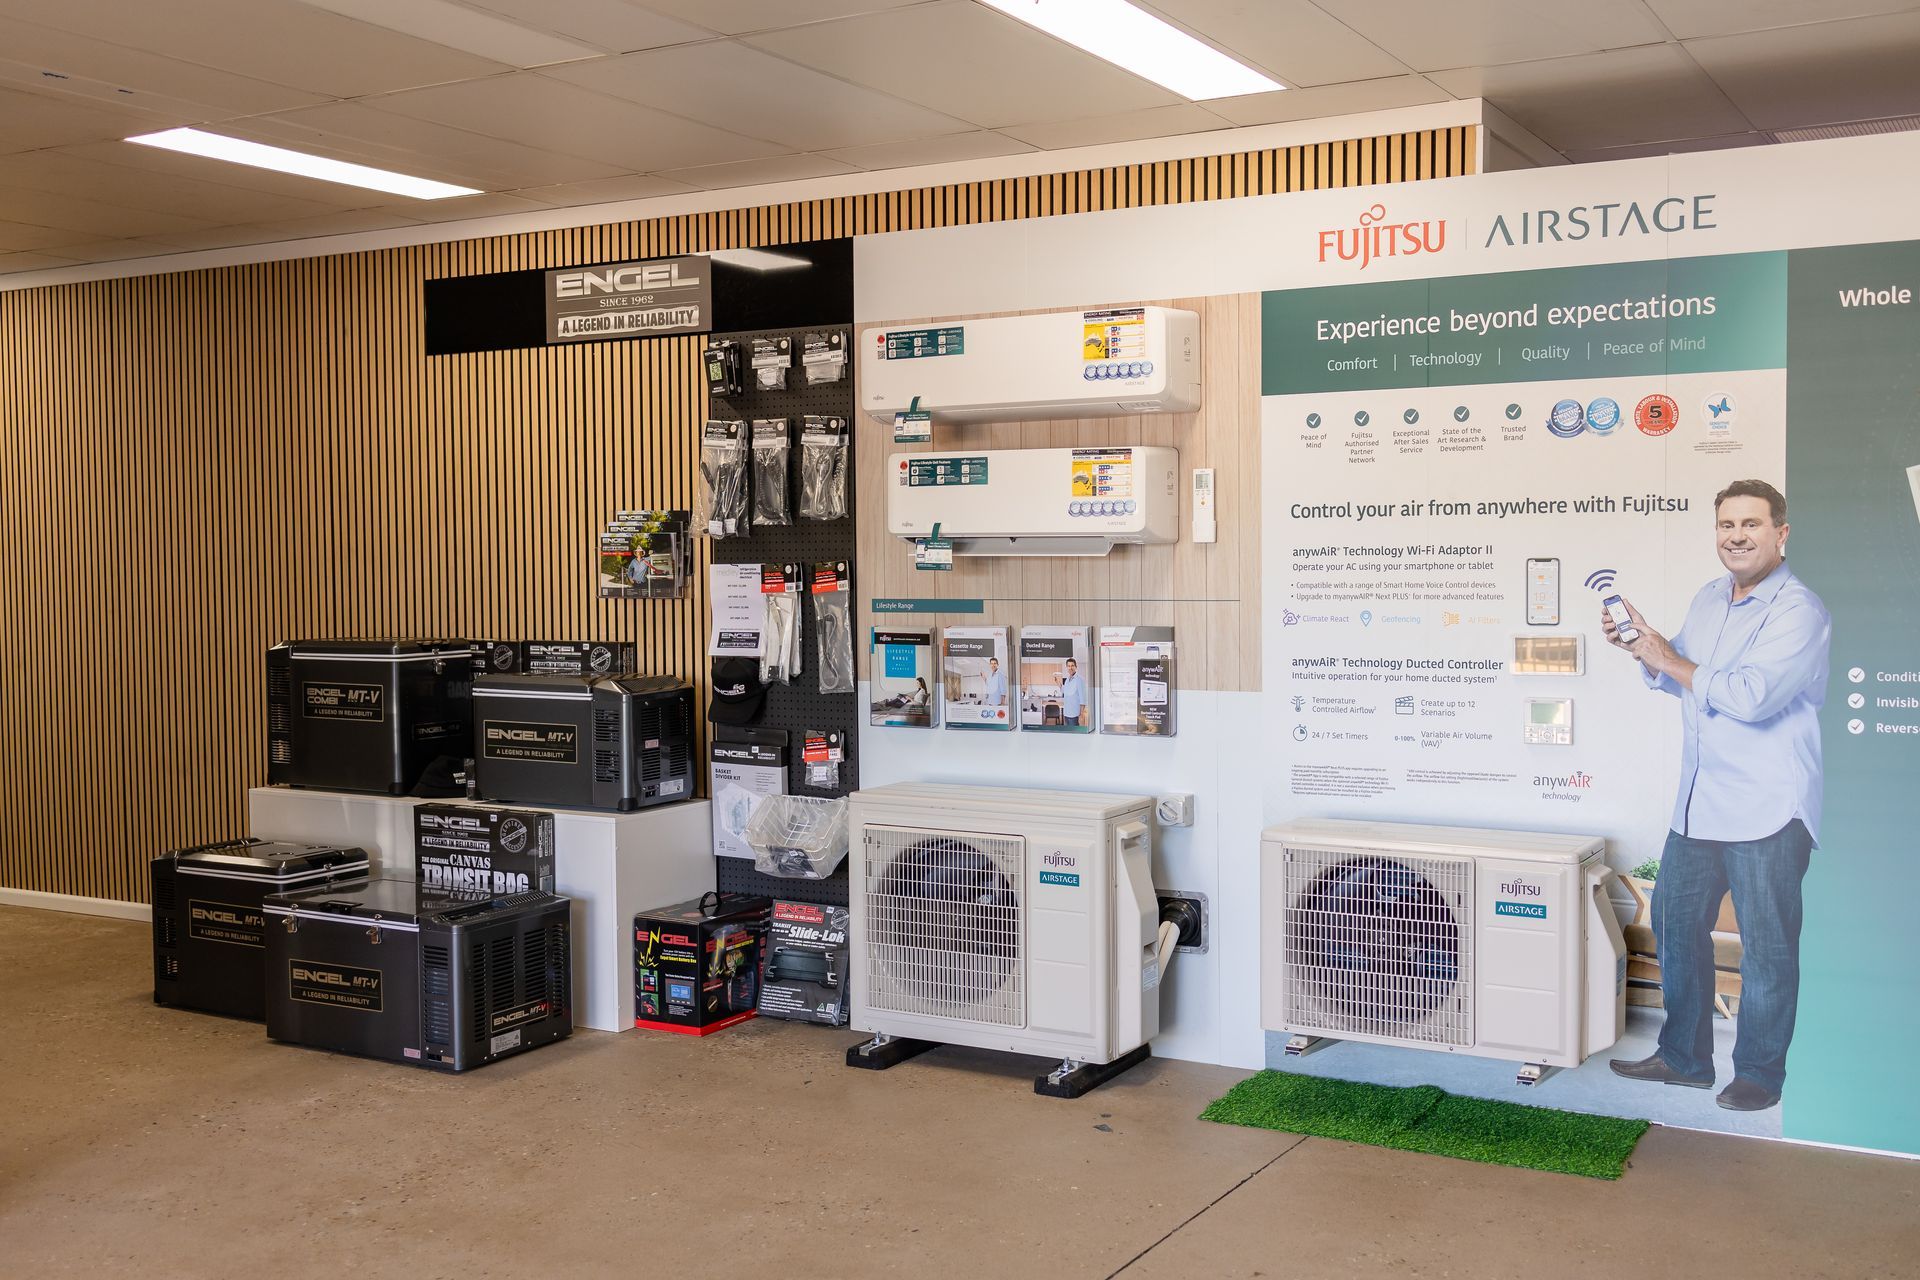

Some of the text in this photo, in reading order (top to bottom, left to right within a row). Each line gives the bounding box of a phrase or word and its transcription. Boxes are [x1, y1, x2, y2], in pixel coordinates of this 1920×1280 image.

[1318, 194, 1717, 270] FUJITSU AIRSTAGE
[556, 264, 700, 297] ENGEL
[600, 295, 654, 307] SINCE 1962
[1839, 285, 1912, 307] Whole
[562, 310, 694, 334] A LEGEND IN RELIABILITY
[1316, 293, 1717, 344] Experience beyond expectations
[1603, 336, 1707, 357] Peace of Mind
[1409, 350, 1483, 369] Technology
[1521, 345, 1571, 363] Quality
[1327, 356, 1378, 372] Comfort
[1649, 406, 1662, 418] 5
[1392, 430, 1430, 438] Exceptional
[1500, 425, 1527, 434] Trusted
[1320, 433, 1327, 441] of
[1351, 432, 1373, 440] Fujitsu
[1450, 436, 1479, 444] Research
[1504, 434, 1524, 442] Brand
[1394, 438, 1410, 446] After
[1350, 448, 1374, 456] Partner
[1400, 446, 1423, 454] Service
[1440, 444, 1484, 453] Development
[1348, 456, 1376, 464] Network
[1290, 494, 1689, 522] Control your air from anywhere with Fujitsu
[1343, 546, 1404, 558] Technology
[1407, 545, 1435, 556] Wi-Fi
[1438, 545, 1483, 558] Adaptor
[1486, 545, 1493, 555] II
[1292, 564, 1324, 573] Operate
[1326, 564, 1344, 573] your
[1346, 563, 1357, 571] AC
[1358, 563, 1381, 573] using
[1384, 564, 1402, 572] your
[1404, 562, 1455, 573] smartphone
[1468, 562, 1494, 570] tablet
[1296, 581, 1332, 590] Compatible
[1334, 581, 1348, 589] with
[1355, 582, 1374, 591] range
[1376, 581, 1382, 589] of
[1384, 581, 1403, 589] Smart
[1405, 581, 1424, 589] Home
[1426, 581, 1444, 589] Voice
[1445, 581, 1469, 589] Control
[1470, 581, 1496, 589] devices
[1296, 592, 1323, 601] Upgrade
[1376, 592, 1391, 600] Next
[1412, 592, 1422, 600] for
[1442, 592, 1475, 601] advanced
[1476, 592, 1504, 600] features
[876, 602, 914, 610] Lifestyle Range
[1302, 615, 1350, 623] Climate React
[1381, 614, 1421, 625] Geofencing
[1042, 642, 1055, 650] Range
[1342, 658, 1403, 670] Technology
[1406, 658, 1445, 669] Ducted
[1447, 660, 1504, 670] Controller
[1292, 672, 1326, 680] Intuitive
[1328, 672, 1368, 682] operation
[1370, 672, 1382, 681] for
[1384, 674, 1403, 683] your
[1406, 673, 1430, 682] home
[1432, 674, 1461, 683] ducted
[306, 687, 380, 704] ENGEL MT-V
[307, 696, 339, 705] COMBI
[1312, 696, 1356, 706] Temperature
[1312, 706, 1349, 714] Controlled
[1420, 699, 1476, 710] Create up to 12
[1420, 708, 1456, 717] Scenarios
[1876, 722, 1920, 734] Revers
[487, 728, 574, 742] ENGEL MT-V
[1326, 732, 1330, 740] 7
[1332, 732, 1344, 740] Set
[1346, 732, 1369, 741] Timers
[1420, 731, 1451, 739] Variable
[1464, 732, 1493, 740] Volume
[531, 750, 564, 759] RELIABILITY
[715, 749, 754, 759] ENGEL
[1542, 792, 1582, 803] technology
[421, 814, 490, 832] ENGEL
[450, 854, 491, 869] CANVAS
[1044, 852, 1075, 868] FUJITSU
[422, 864, 529, 894] TRANSIT BAG
[1042, 874, 1078, 884] AIRSTAGE
[1501, 878, 1541, 897] FUJITSU
[775, 903, 824, 916] ENGEL
[1498, 904, 1544, 916] AIRSTAGE
[192, 908, 243, 925] ENGEL
[637, 926, 698, 947] ENGEL
[788, 926, 845, 944] Slide-Lok
[293, 968, 378, 989] ENGEL MT-V
[308, 991, 329, 1000] LEGEND
[336, 994, 370, 1006] RELIABILITY
[494, 1004, 547, 1027] ENGEL MT-V
